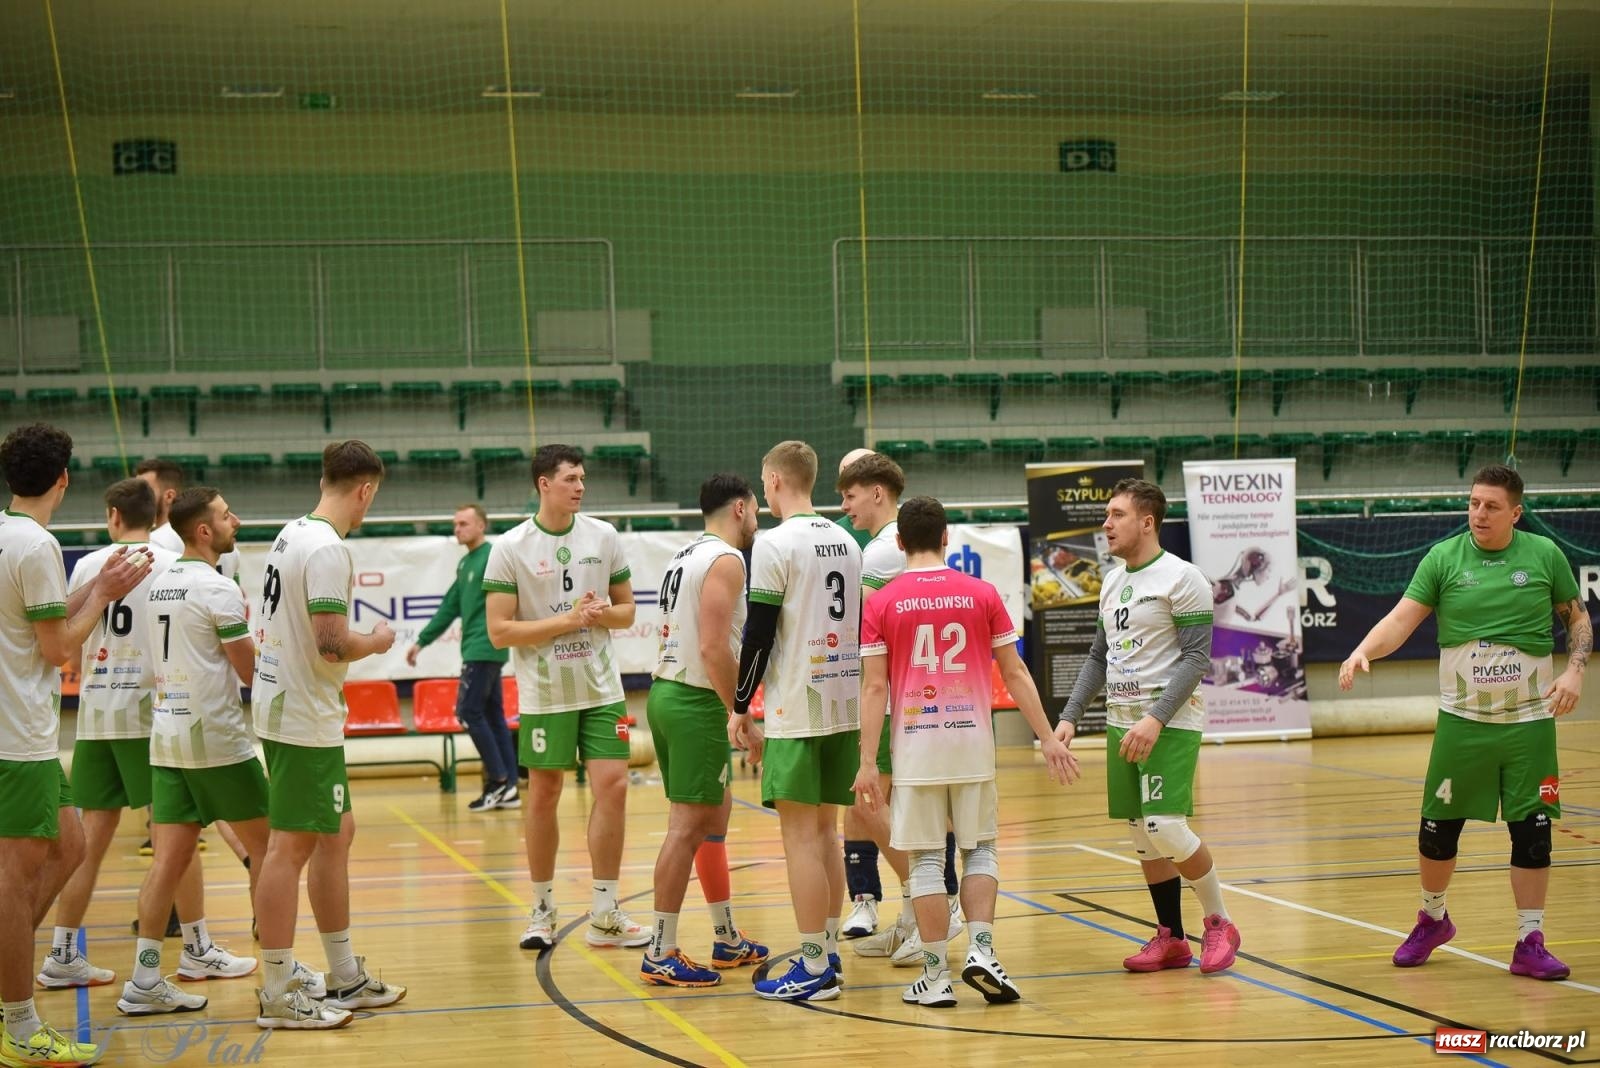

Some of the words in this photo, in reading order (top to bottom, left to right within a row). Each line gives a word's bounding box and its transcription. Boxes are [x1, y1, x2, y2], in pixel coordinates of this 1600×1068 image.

[1199, 473, 1283, 492] PIVEXIN
[1202, 491, 1283, 505] TECHNOLOGY
[814, 543, 848, 557] RZYTKI
[562, 569, 574, 592] 6
[660, 566, 683, 614] 49
[825, 571, 846, 621] 3
[895, 595, 974, 614] SOKOŁOWSKI
[1114, 606, 1130, 632] 12
[158, 614, 171, 662] 7
[911, 622, 967, 674] 42
[1472, 662, 1522, 677] PIVEXIN
[1473, 674, 1522, 684] TECHNOLOGY
[532, 727, 547, 753] 6
[333, 784, 345, 814] 9
[1141, 774, 1163, 804] 12
[1435, 778, 1453, 805] 4
